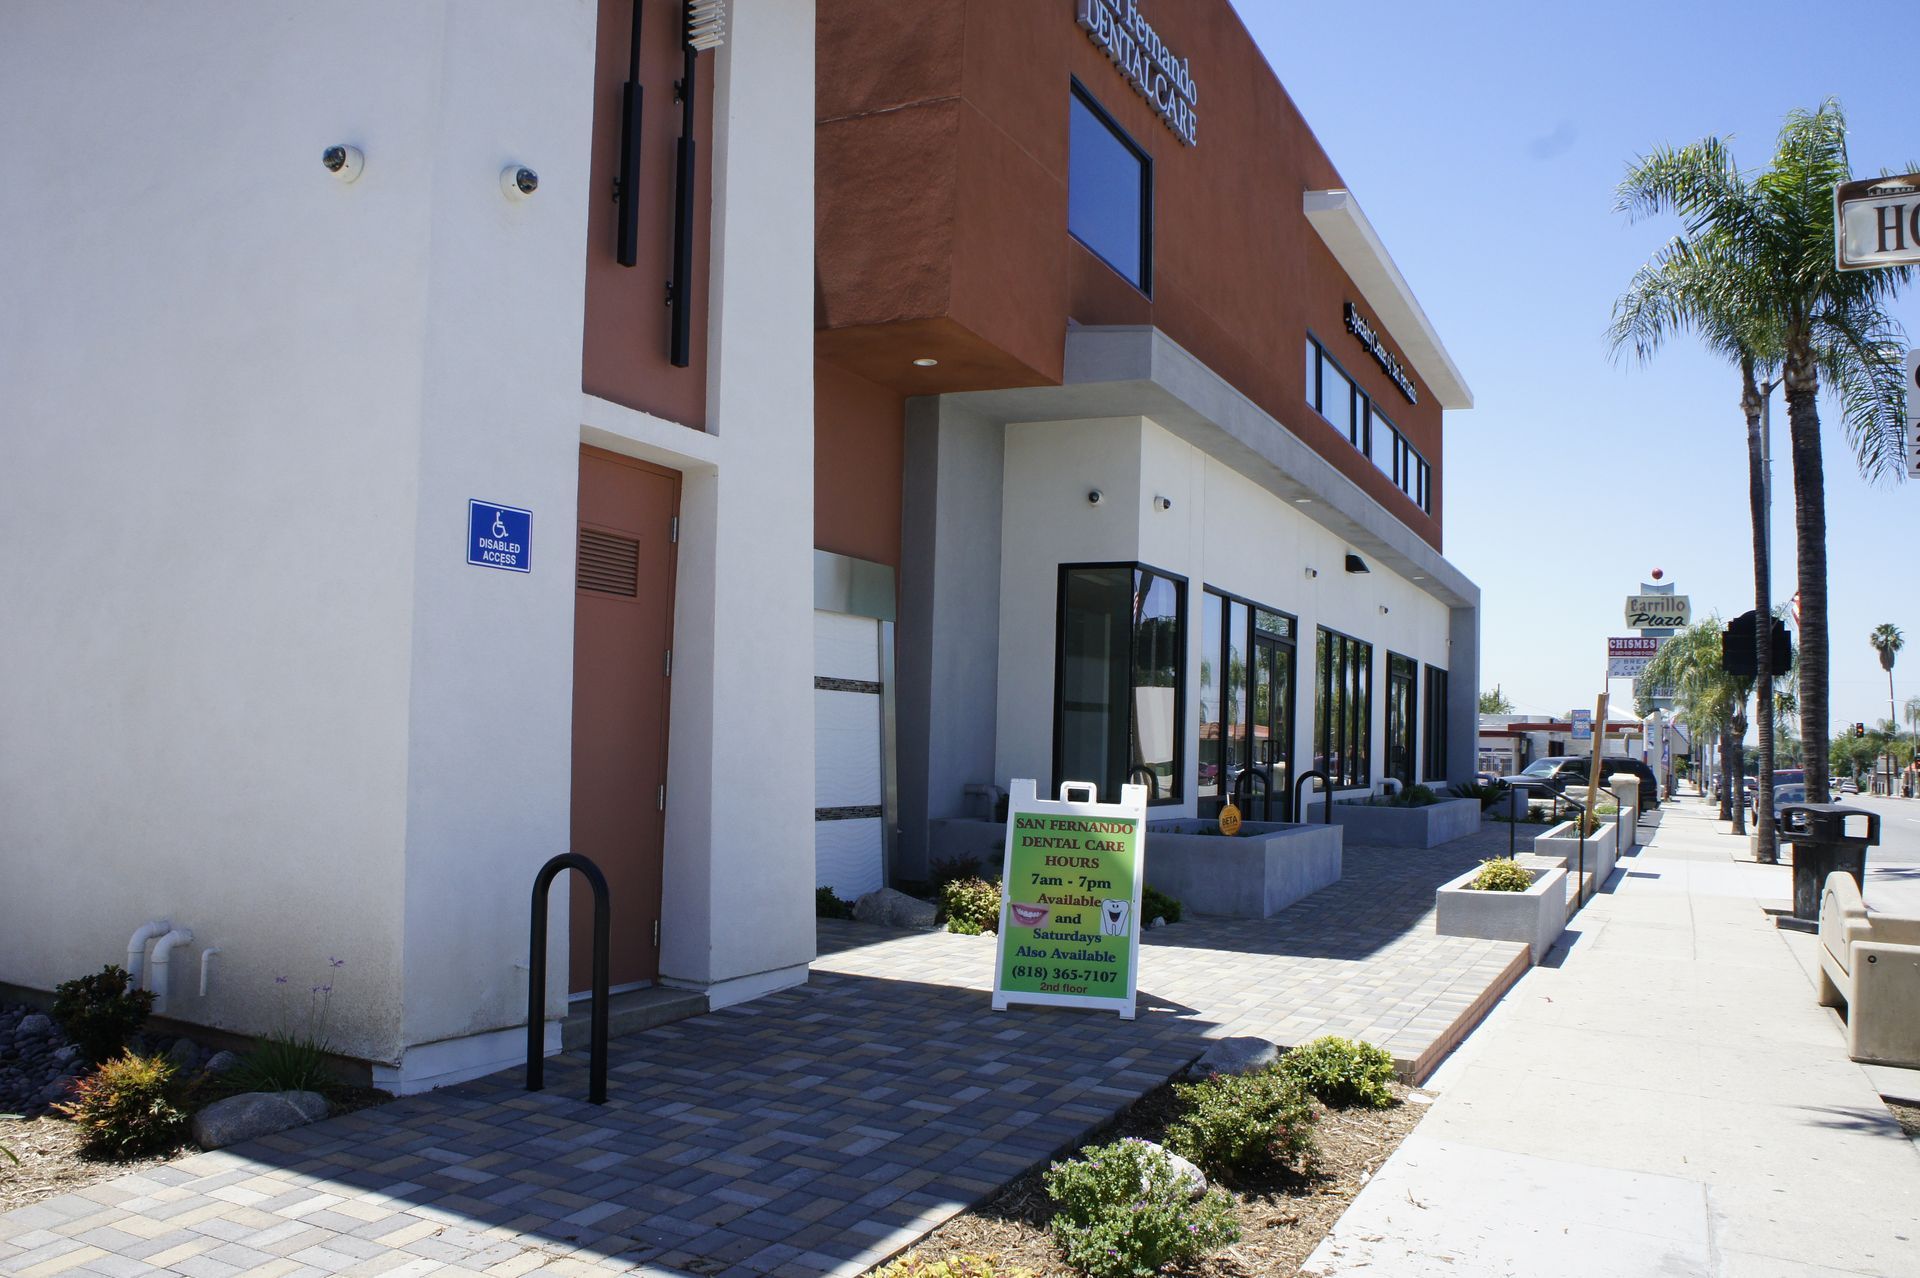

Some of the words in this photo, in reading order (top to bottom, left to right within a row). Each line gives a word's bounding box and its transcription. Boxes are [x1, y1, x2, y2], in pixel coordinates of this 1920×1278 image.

[1087, 0, 1155, 98] DENTAL
[1155, 73, 1197, 147] CARE
[479, 537, 520, 553] DISABLED
[482, 550, 516, 565] ACCESS
[1630, 598, 1685, 612] Carrillo
[1629, 612, 1687, 626] Plaza
[1609, 639, 1656, 649] CHISMES
[1016, 817, 1045, 830] SAN
[1050, 819, 1134, 834] FERNANDO
[1022, 836, 1080, 850] DENTAL
[1085, 840, 1125, 852] CARE
[1045, 855, 1100, 869] HOURS
[1031, 873, 1063, 886] 7am
[1079, 876, 1112, 891] 7pm
[1037, 893, 1102, 907] Available
[1055, 913, 1082, 925] and
[1033, 928, 1102, 946] Saturdays
[1016, 945, 1047, 958] Also
[1051, 948, 1116, 963] Available
[1012, 965, 1048, 980] (818)
[1052, 968, 1118, 983] 365-7107
[1040, 981, 1060, 992] 2nd
[1062, 983, 1088, 994] floor
